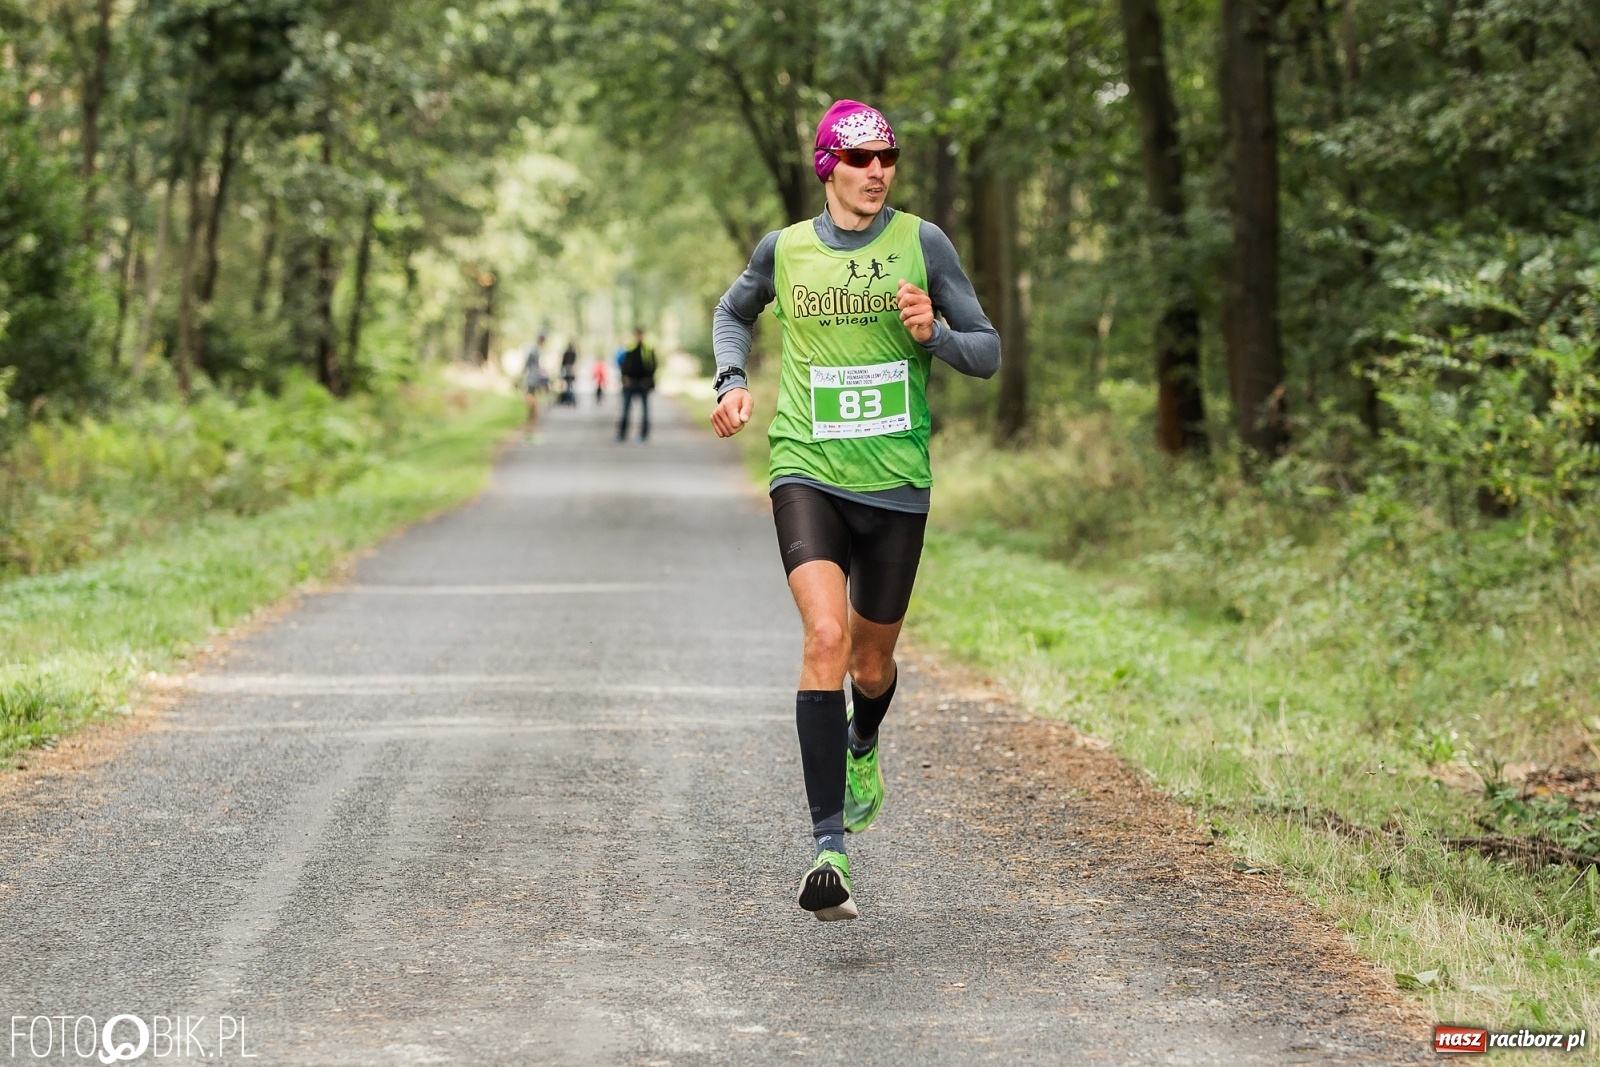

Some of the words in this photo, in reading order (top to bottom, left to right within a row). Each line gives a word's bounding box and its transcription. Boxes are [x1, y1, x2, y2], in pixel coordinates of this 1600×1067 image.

[819, 319, 832, 327] w
[836, 316, 878, 326] biegu
[838, 370, 846, 386] V
[839, 389, 882, 419] 83
